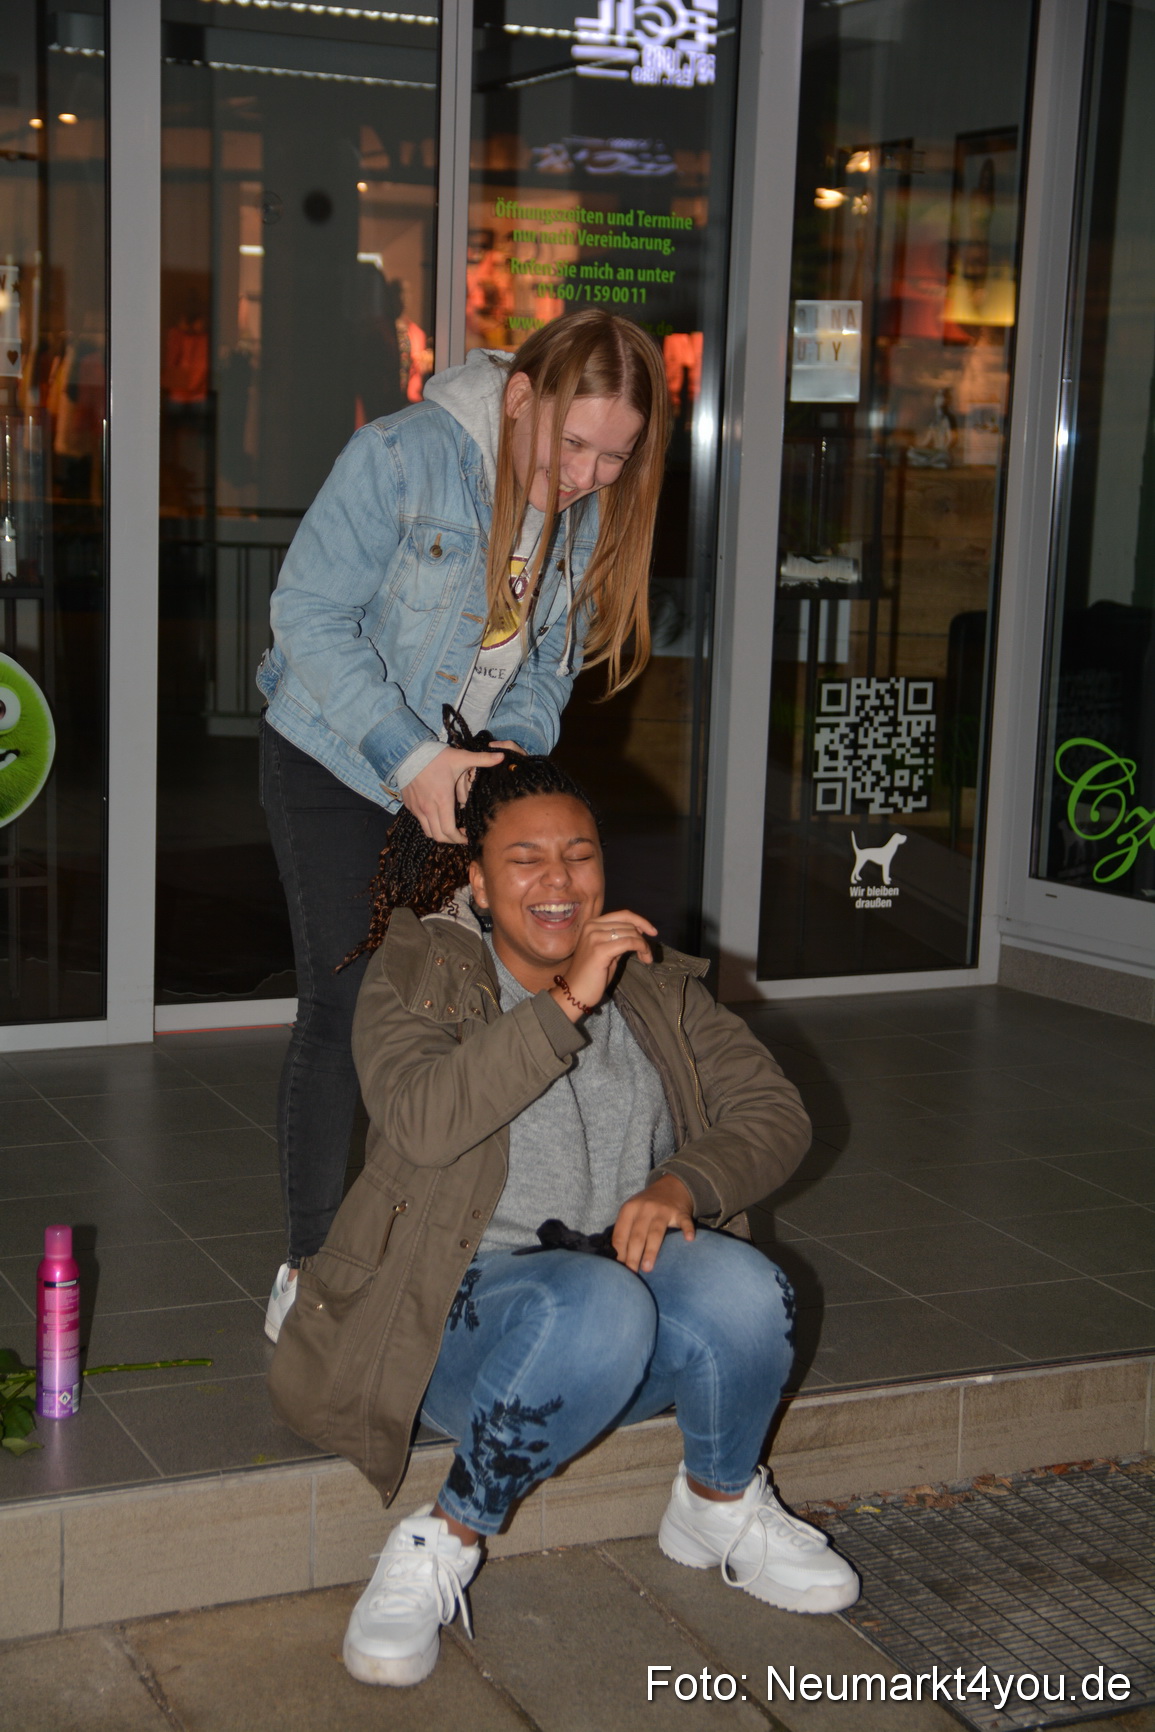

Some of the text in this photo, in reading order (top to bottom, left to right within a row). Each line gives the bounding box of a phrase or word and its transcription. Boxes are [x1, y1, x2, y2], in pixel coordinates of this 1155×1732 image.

[495, 197, 693, 230] Öffnungszeiten und Termine
[513, 229, 675, 256] nur nach Vereinbarung.
[510, 257, 676, 283] Rufen Sie mich an unter
[850, 886, 900, 897] Wir bleiben
[855, 897, 893, 909] draußen
